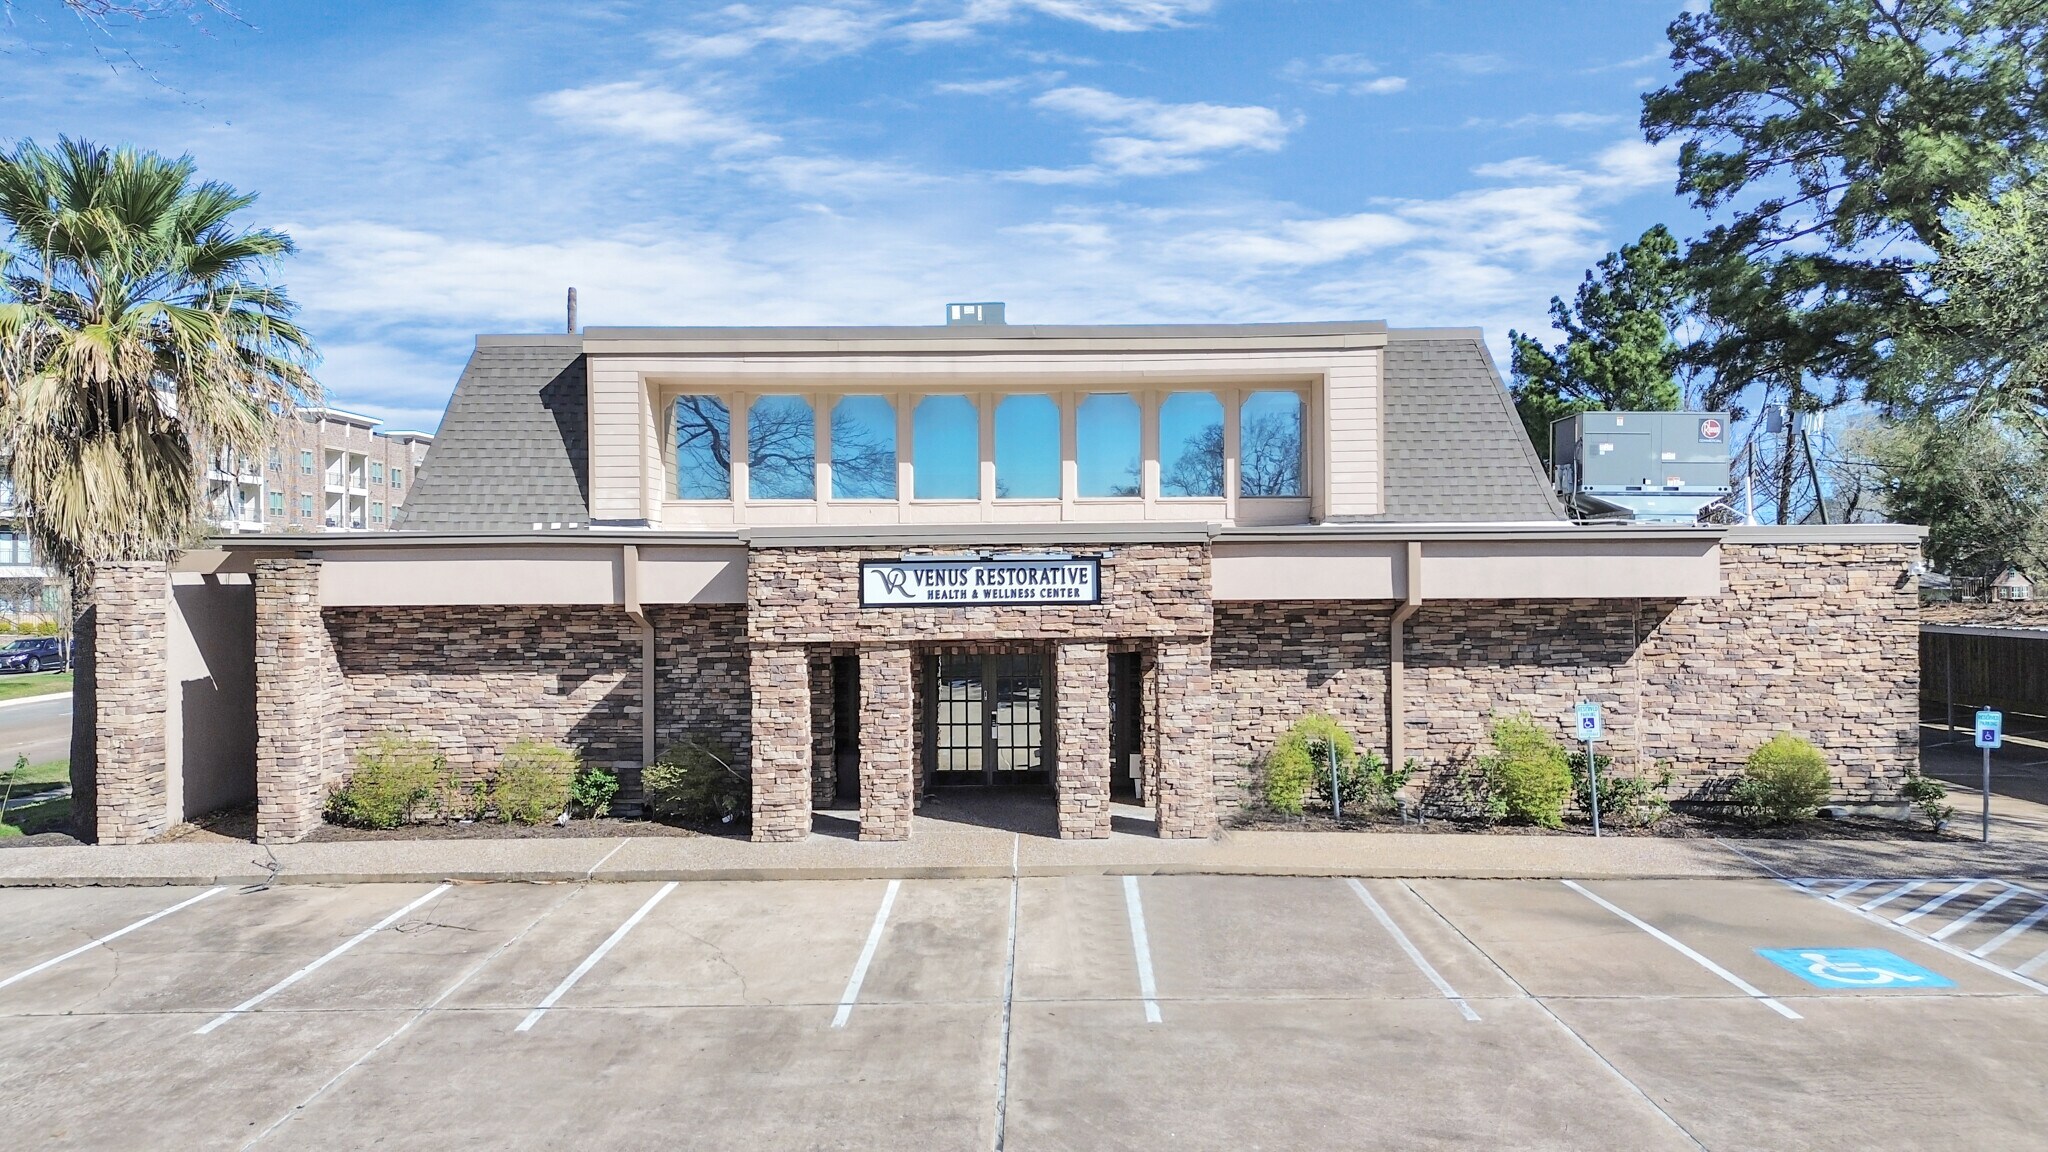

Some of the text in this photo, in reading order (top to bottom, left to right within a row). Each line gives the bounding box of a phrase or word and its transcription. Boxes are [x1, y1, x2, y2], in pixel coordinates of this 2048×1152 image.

[914, 567, 1088, 587] VENUS RESTORATIVE
[927, 587, 1080, 600] HEALTH & WELLNESS CENTER
